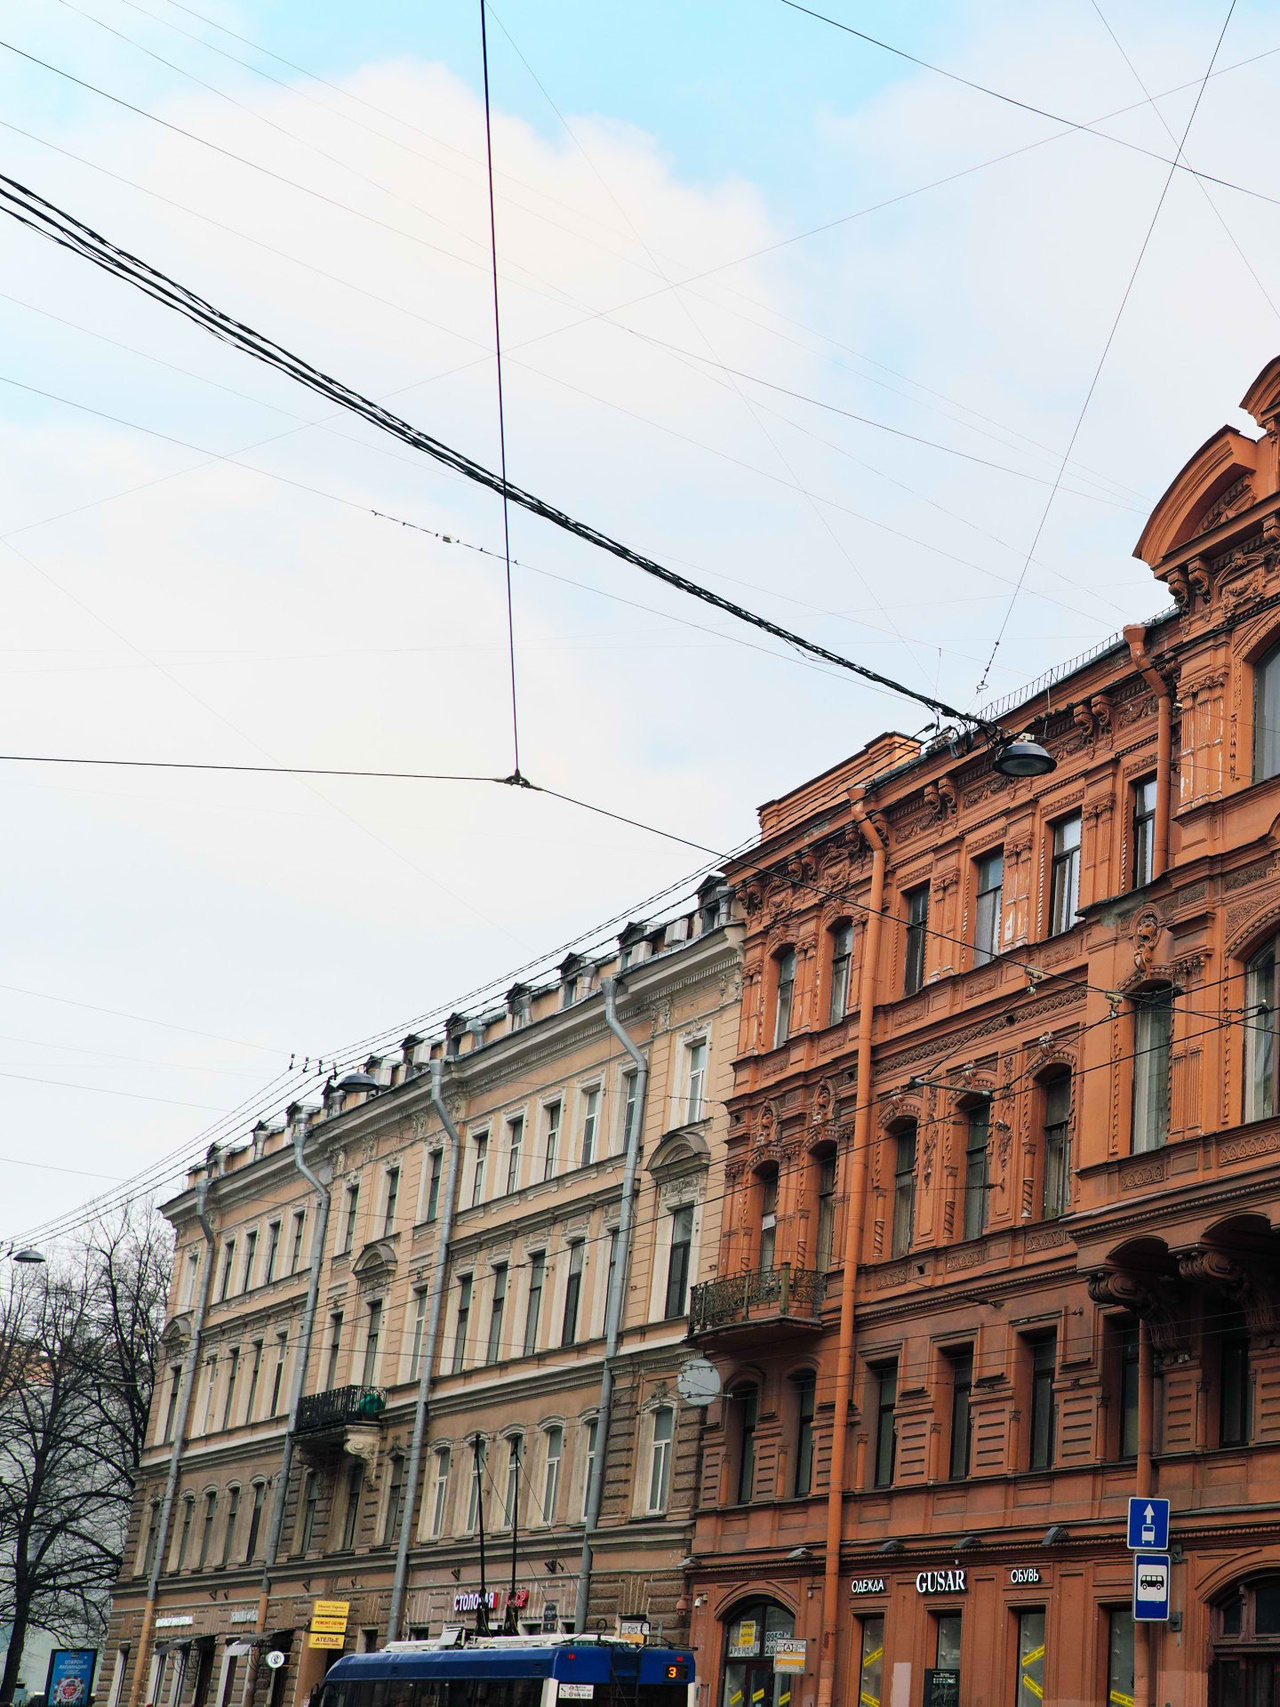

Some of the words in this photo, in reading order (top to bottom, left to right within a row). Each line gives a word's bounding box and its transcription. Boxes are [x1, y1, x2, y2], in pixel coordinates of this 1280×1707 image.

[916, 1569, 966, 1593] GUSAR
[1011, 1569, 1039, 1584] ОБУВЬ
[851, 1579, 885, 1593] ОДЕЖДА
[668, 1666, 677, 1678] 3
